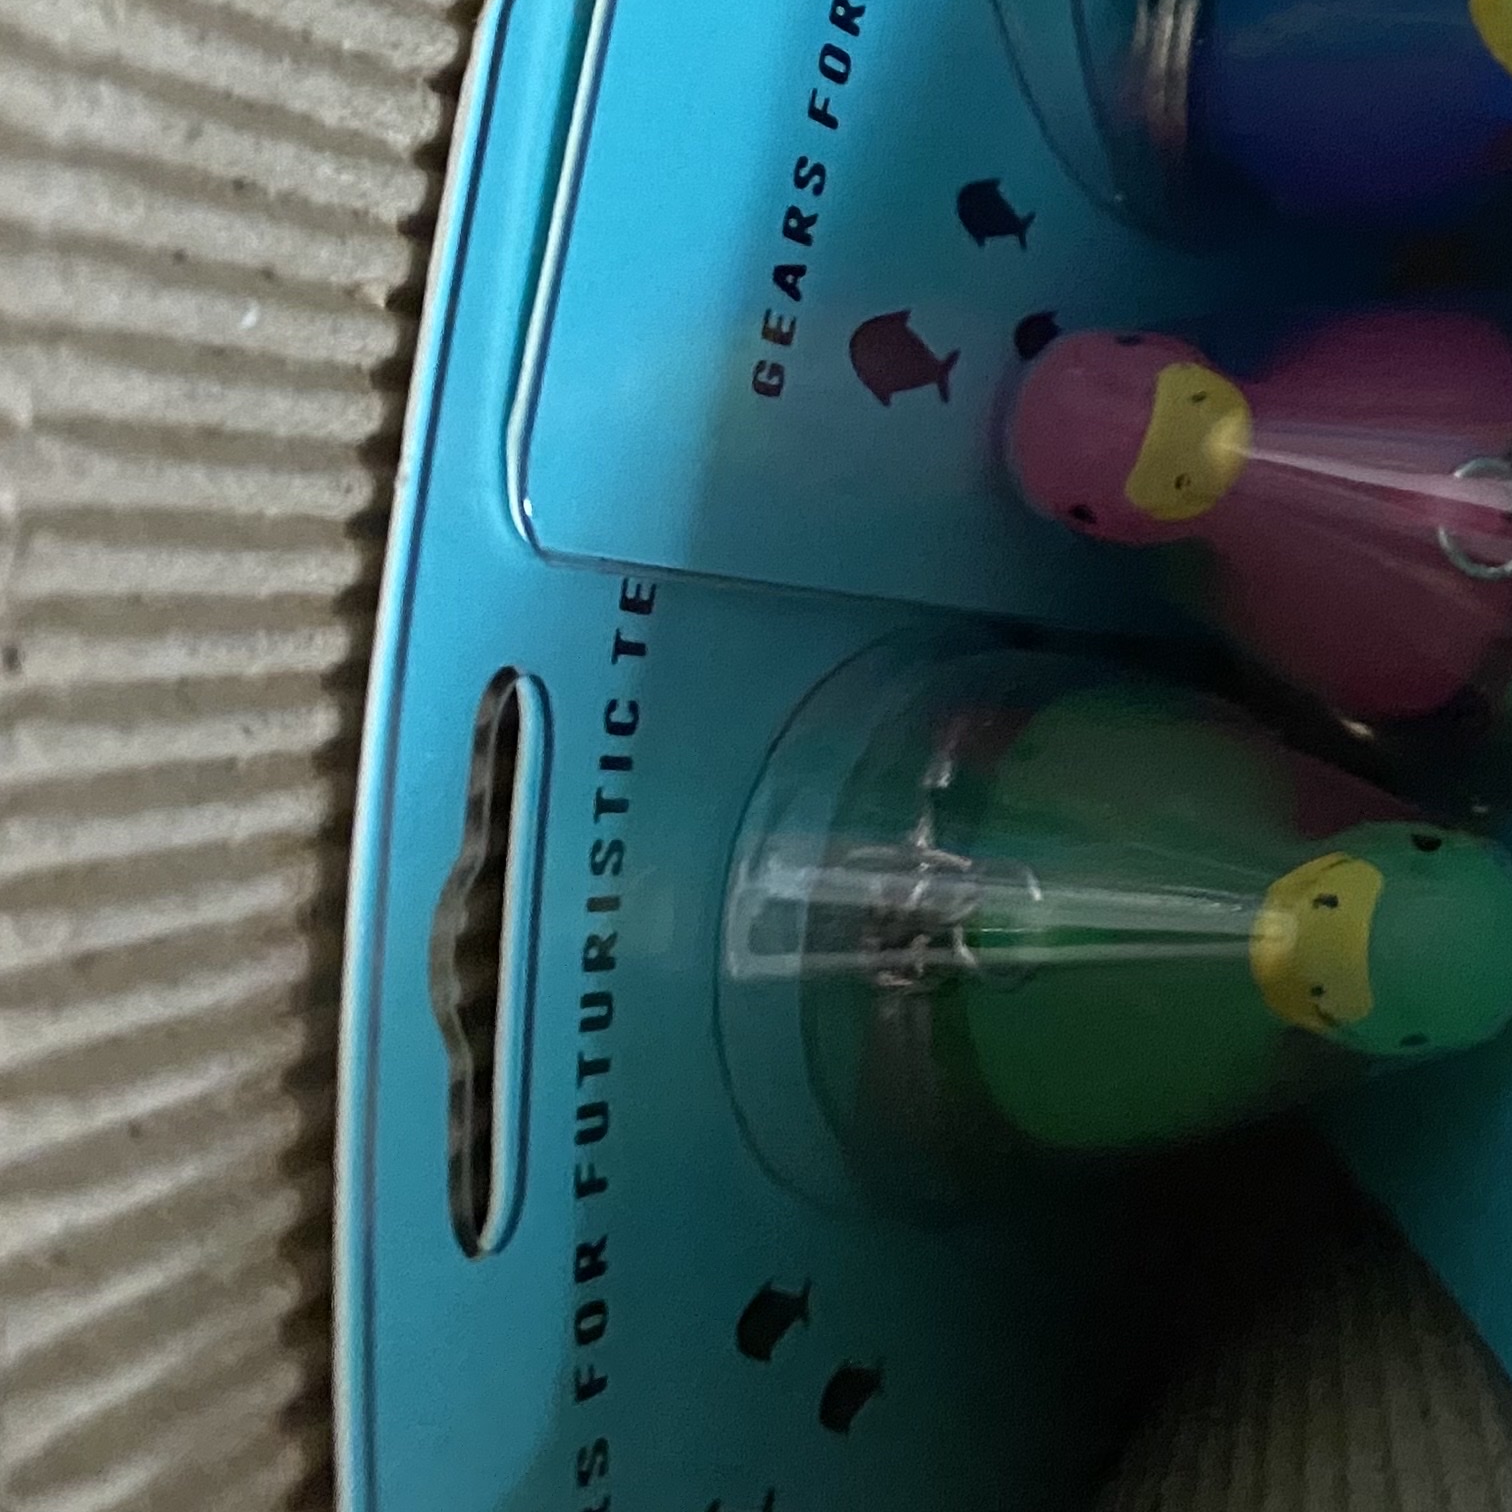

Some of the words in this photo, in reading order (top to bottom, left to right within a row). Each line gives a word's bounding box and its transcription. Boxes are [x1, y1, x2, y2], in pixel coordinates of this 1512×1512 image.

[752, 155, 827, 398] GEARS
[573, 698, 640, 1201] FUTURISTIC
[573, 1234, 609, 1405] FOR
